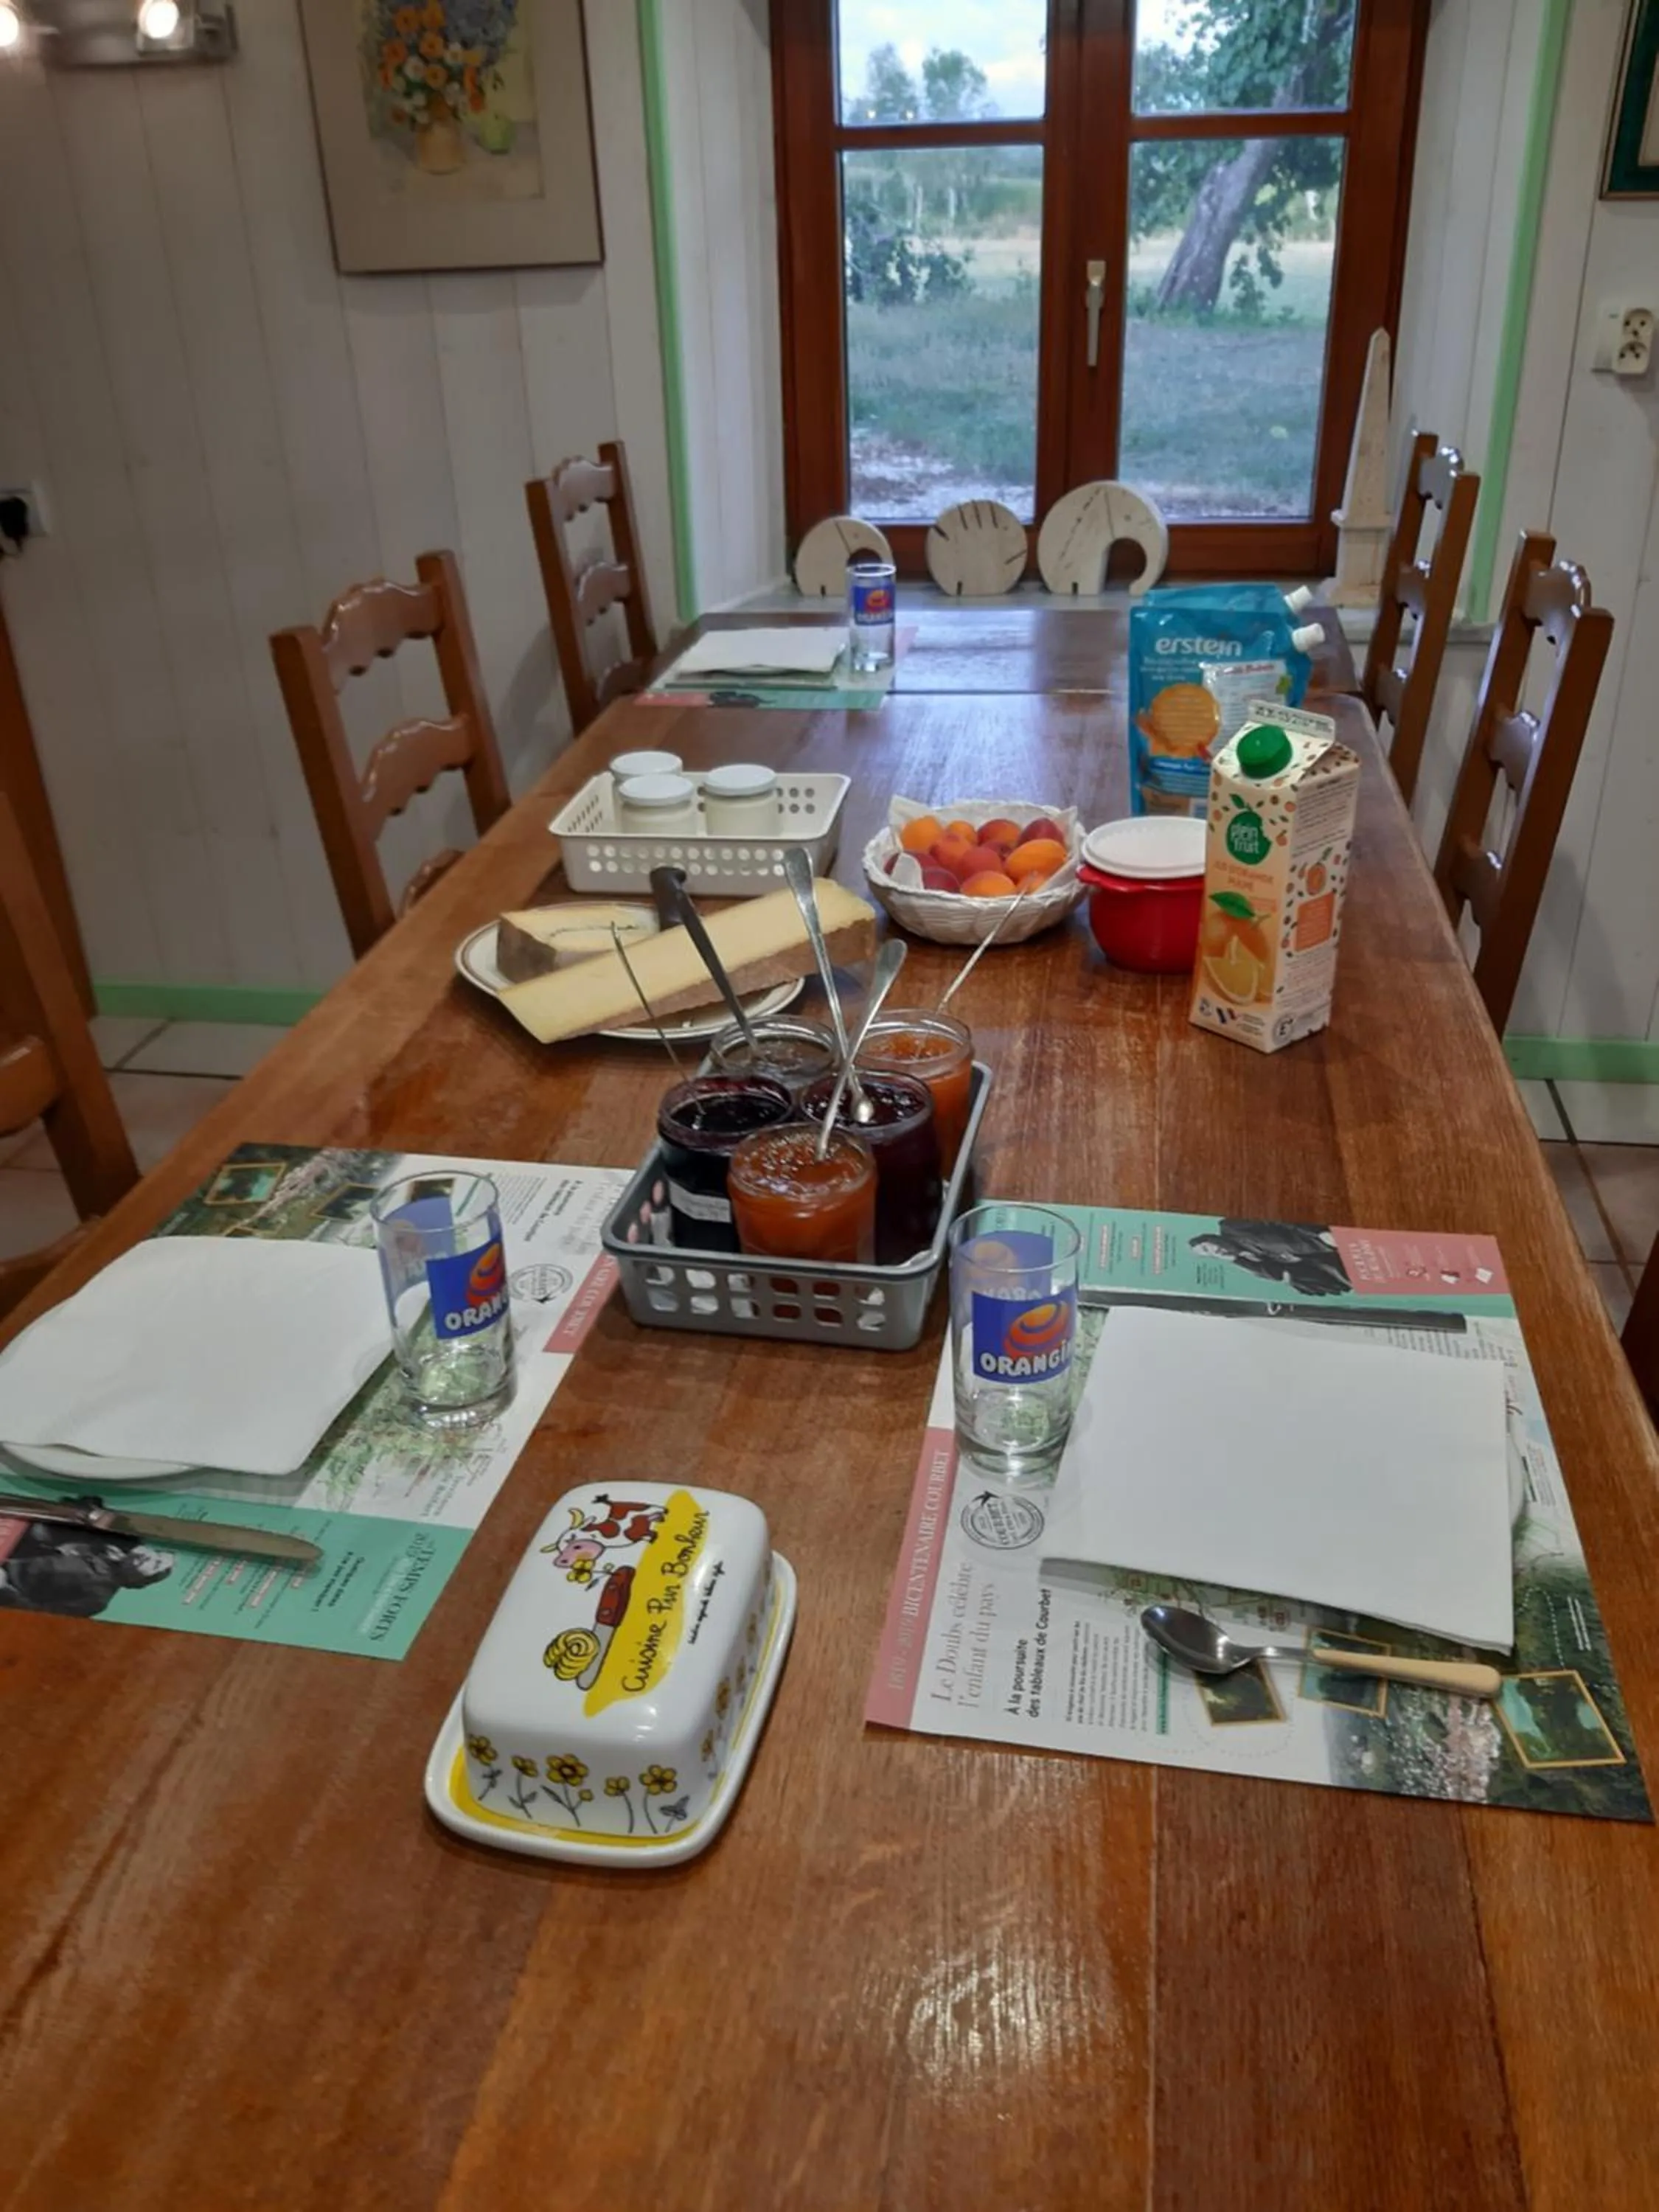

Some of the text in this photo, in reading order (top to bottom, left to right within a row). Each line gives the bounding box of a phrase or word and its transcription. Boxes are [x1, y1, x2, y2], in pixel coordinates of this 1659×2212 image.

[1155, 635, 1242, 657] erstein
[1234, 838, 1259, 855] fruit
[445, 1292, 507, 1331] ORAN
[978, 1583, 998, 1617] pays
[936, 1621, 962, 1674] Doubs
[969, 1621, 991, 1644] du
[622, 1620, 667, 1693] Cuisine
[1012, 1638, 1029, 1692] poursuite
[1026, 1587, 1052, 1718] des tableaux de Courbet
[1007, 1694, 1022, 1705] la
